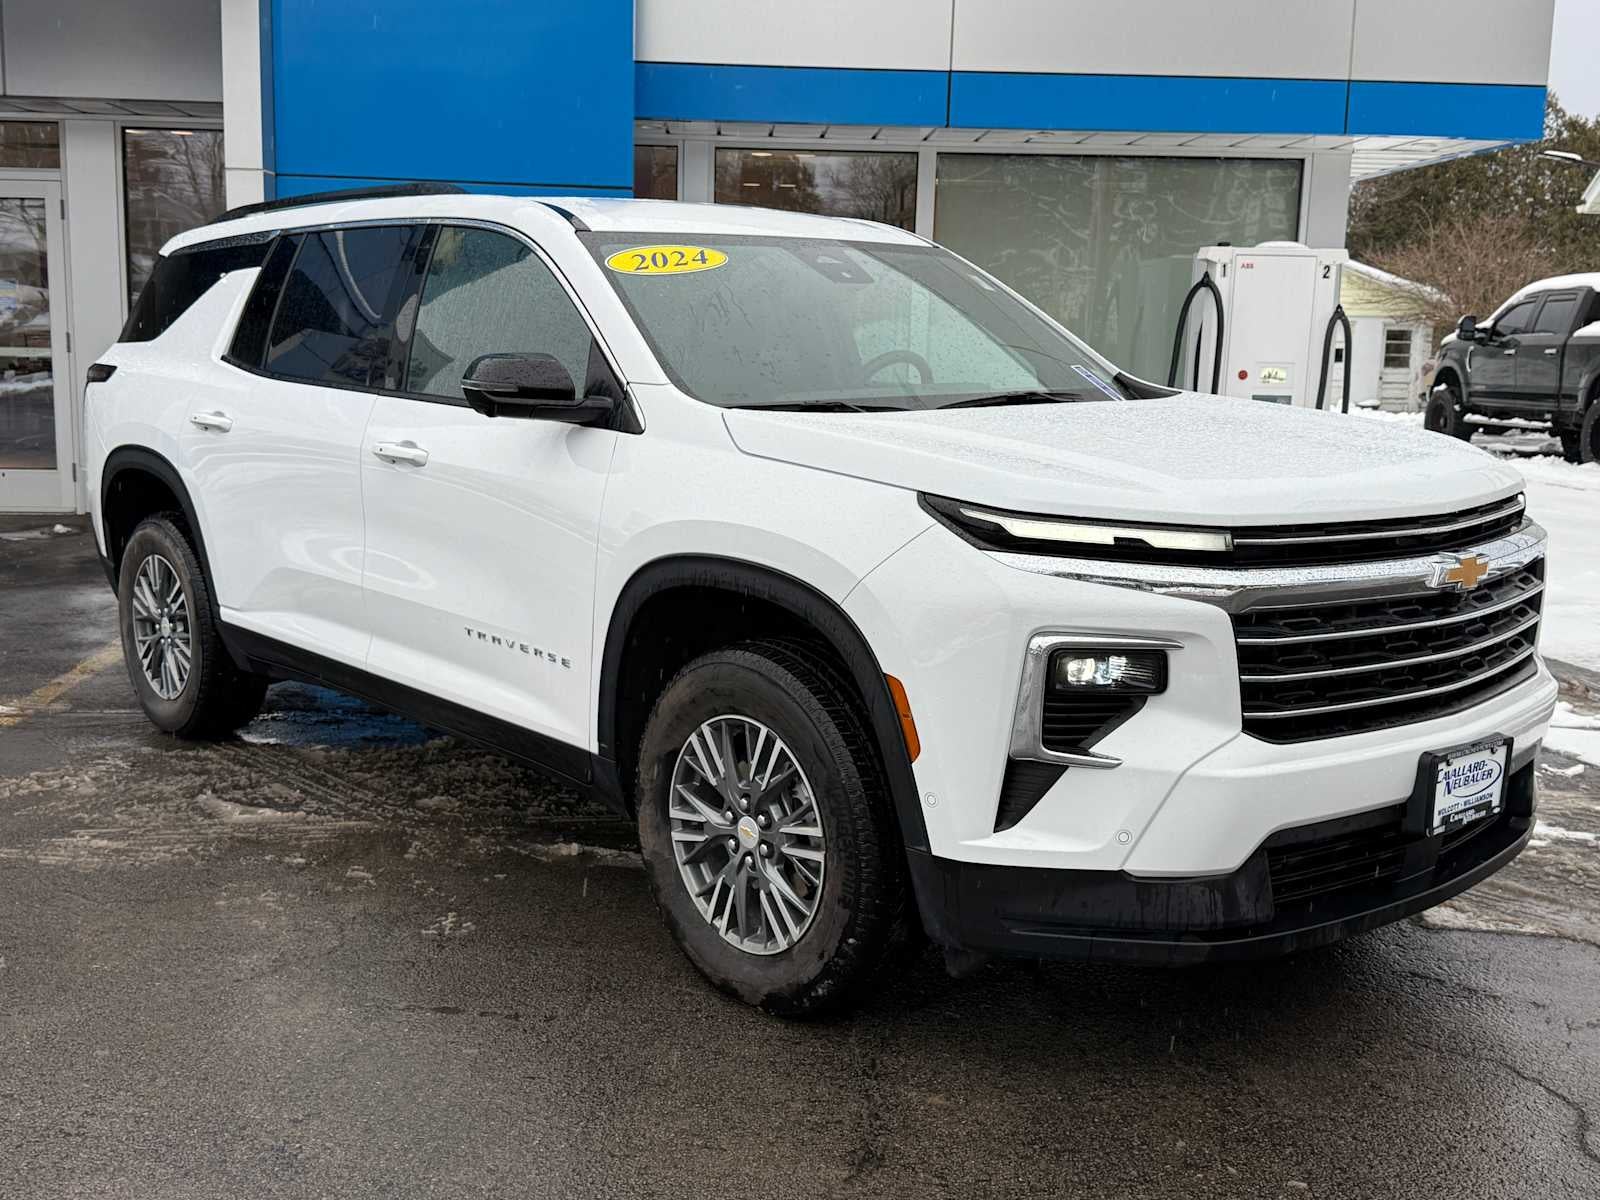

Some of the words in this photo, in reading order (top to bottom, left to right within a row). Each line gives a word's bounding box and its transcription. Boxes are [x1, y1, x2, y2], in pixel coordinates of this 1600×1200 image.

[631, 250, 709, 271] 2024
[1322, 265, 1330, 279] 2
[464, 627, 571, 669] TRAVERSE
[1443, 768, 1493, 797] NEUBAUER
